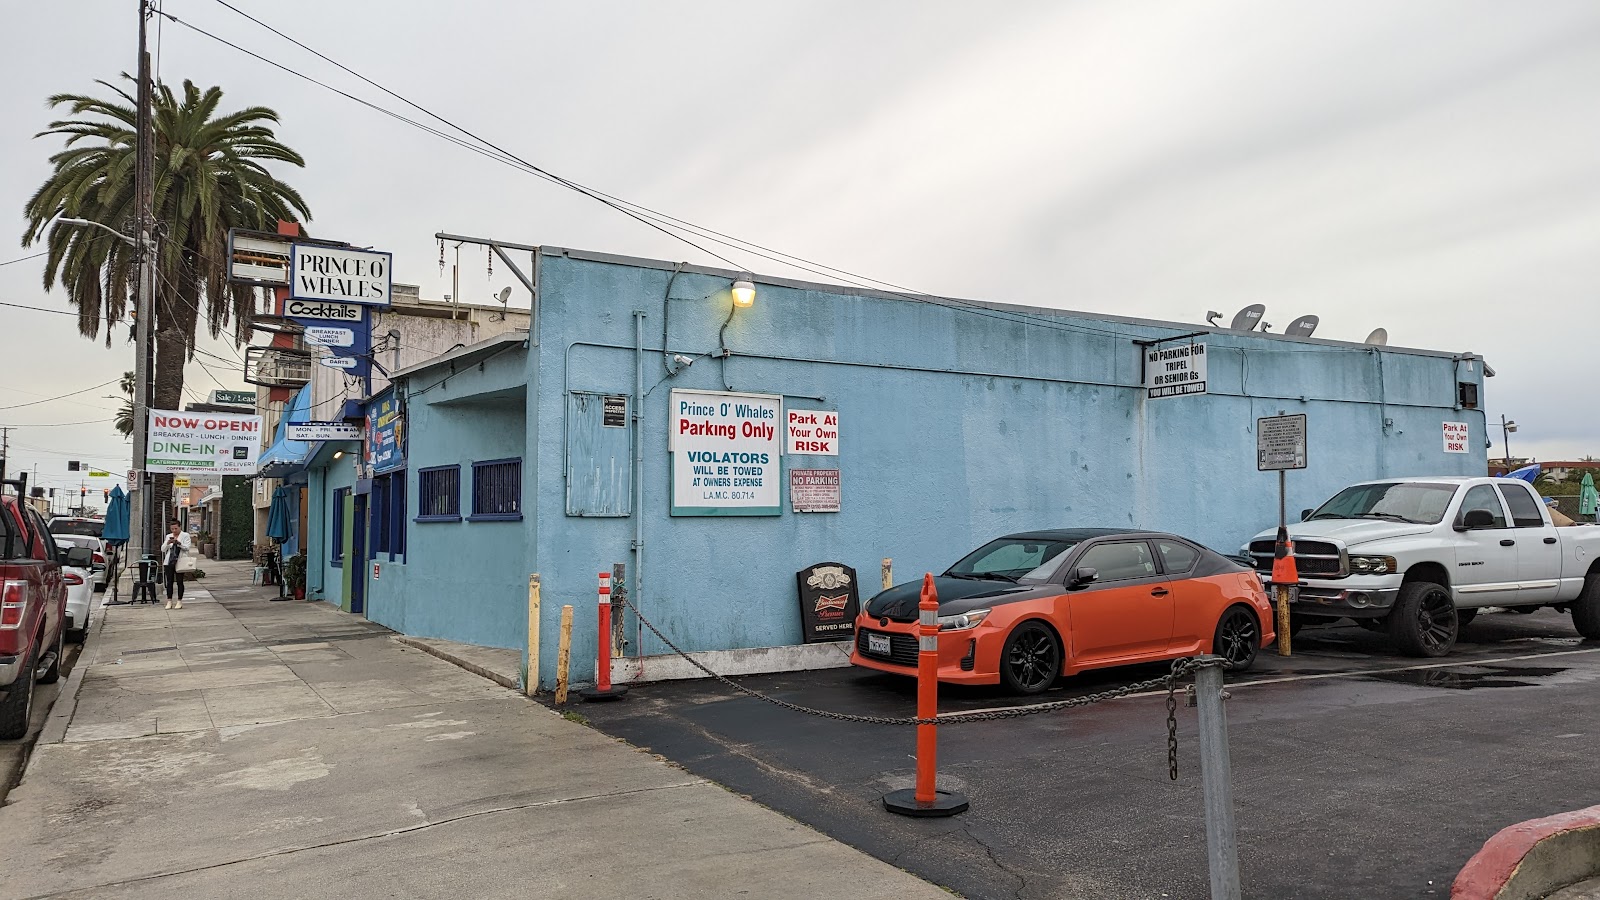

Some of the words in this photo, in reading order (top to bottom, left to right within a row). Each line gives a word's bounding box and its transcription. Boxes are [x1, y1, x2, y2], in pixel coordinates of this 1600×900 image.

[300, 253, 366, 277] PRINCE
[370, 257, 386, 279] O'
[300, 275, 383, 298] WHALES
[289, 301, 357, 319] Cocktails
[1148, 352, 1158, 362] NO
[1159, 347, 1190, 361] PARKING
[1191, 344, 1204, 356] FOR
[1165, 360, 1188, 372] TRIPEL
[1154, 375, 1164, 385] OR
[1164, 371, 1189, 384] SENIOR
[1149, 388, 1161, 397] YOU
[1161, 386, 1176, 396] WILL
[1175, 386, 1183, 395] BE
[1184, 383, 1205, 393] TOWED
[680, 401, 715, 416] Prince
[720, 402, 731, 417] O'
[735, 402, 774, 419] Whales
[154, 416, 200, 429] NOW
[203, 419, 259, 432] OPEN!
[789, 412, 817, 425] Park
[824, 414, 837, 426] At
[680, 418, 736, 440] Parking
[742, 421, 774, 441] Only
[789, 426, 811, 439] Your
[815, 427, 837, 439] Own
[1443, 423, 1458, 432] Park
[1460, 424, 1467, 432] At
[153, 431, 194, 439] BREAKFAST
[1444, 432, 1455, 440] Your
[1456, 432, 1467, 441] Own
[152, 441, 215, 455] DINE-IN
[795, 440, 829, 452] RISK
[1448, 442, 1464, 451] RISK
[687, 451, 769, 465] VIOLATORS
[693, 465, 713, 475] WILL
[717, 466, 729, 475] BE
[733, 466, 763, 476] TOWED
[692, 477, 701, 487] AT
[703, 477, 731, 487] OWNERS
[733, 478, 763, 487] EXPENSE
[792, 476, 804, 485] NO
[805, 476, 838, 485] PARKING
